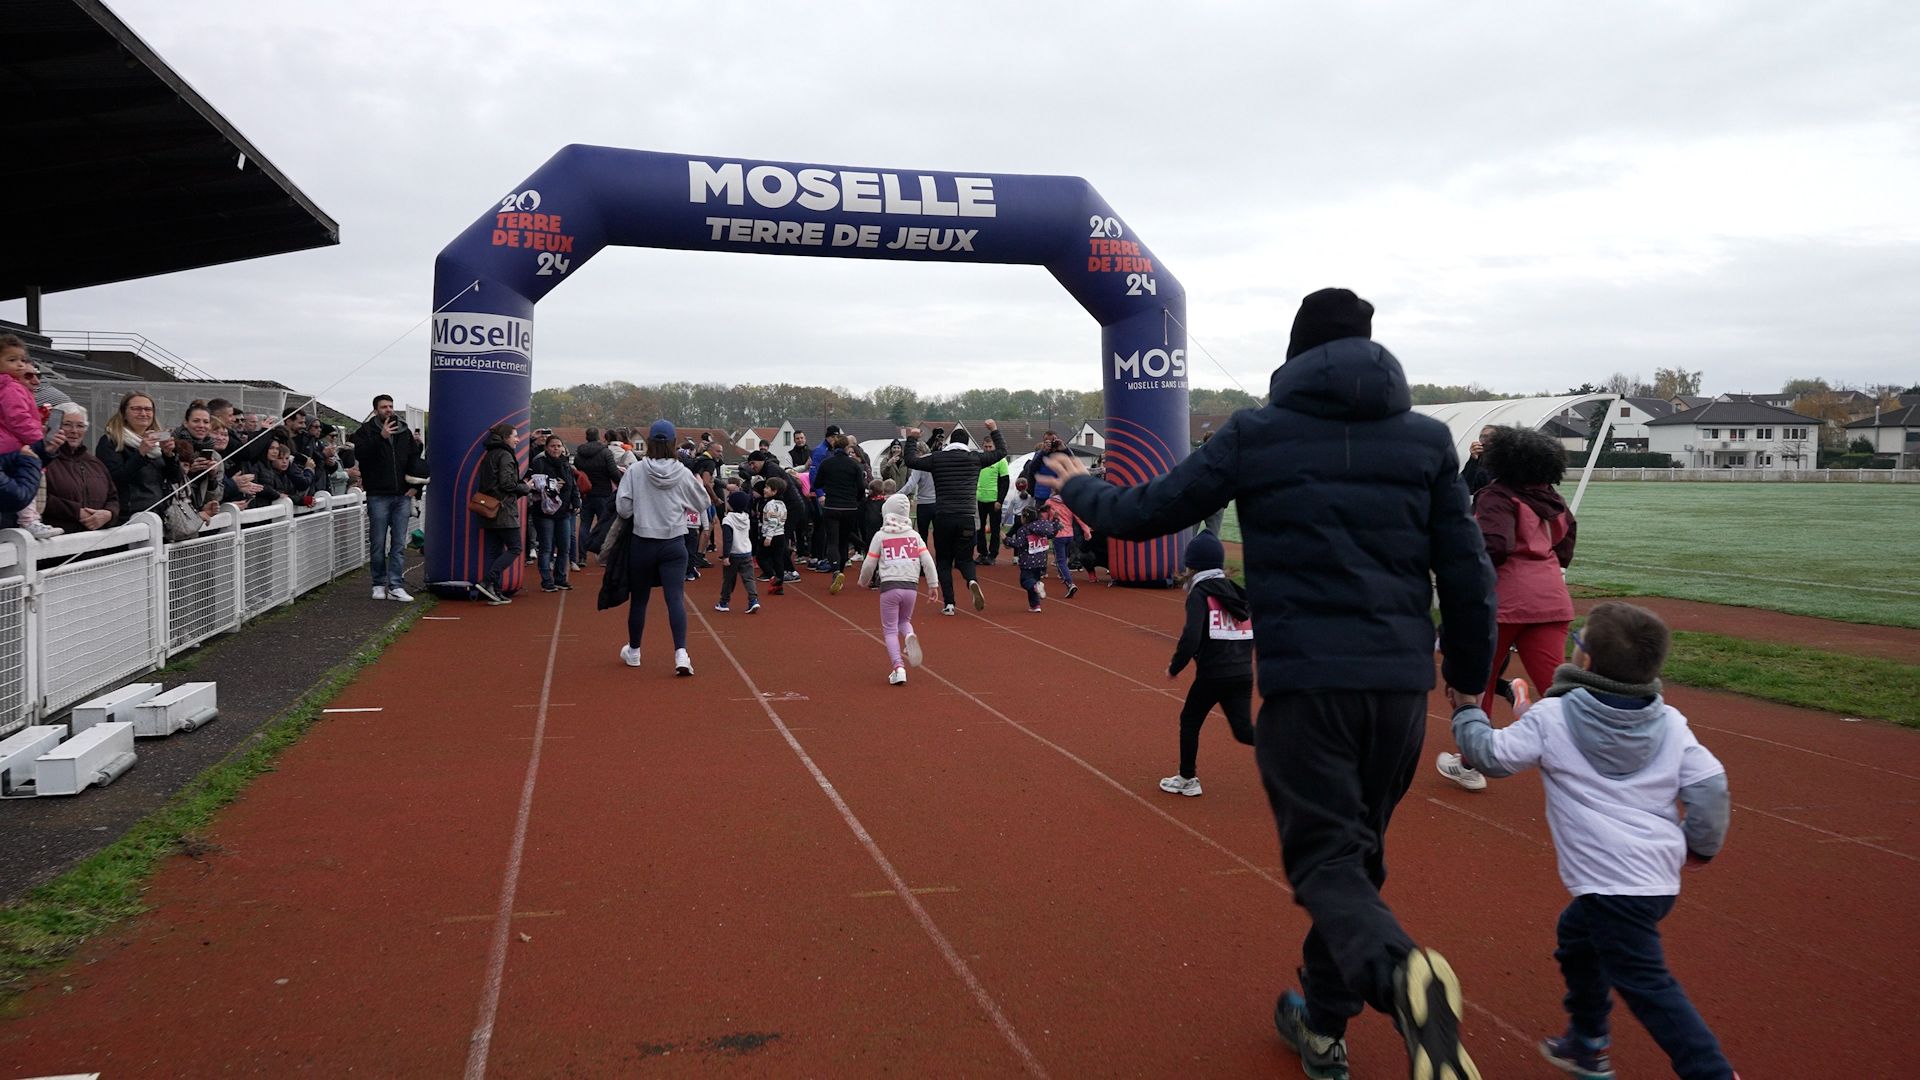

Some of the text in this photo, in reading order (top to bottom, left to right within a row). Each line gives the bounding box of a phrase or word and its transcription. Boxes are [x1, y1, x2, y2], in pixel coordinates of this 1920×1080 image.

[688, 160, 997, 218] MOSELLE
[496, 212, 562, 233] TERRE
[492, 229, 574, 253] DE JEUX
[705, 217, 979, 251] TERRE DE JEUX
[1088, 239, 1142, 256] TERRE
[536, 252, 570, 275] 24
[1088, 257, 1154, 272] DE JEUX
[1126, 273, 1157, 295] 24
[433, 318, 530, 351] Moselle
[434, 356, 528, 373] L'Eurodépartement
[1114, 348, 1188, 379] MOS
[1161, 380, 1177, 389] SANS
[883, 545, 909, 560] ELA
[1028, 539, 1043, 549] ELA
[1210, 609, 1236, 631] ELA
